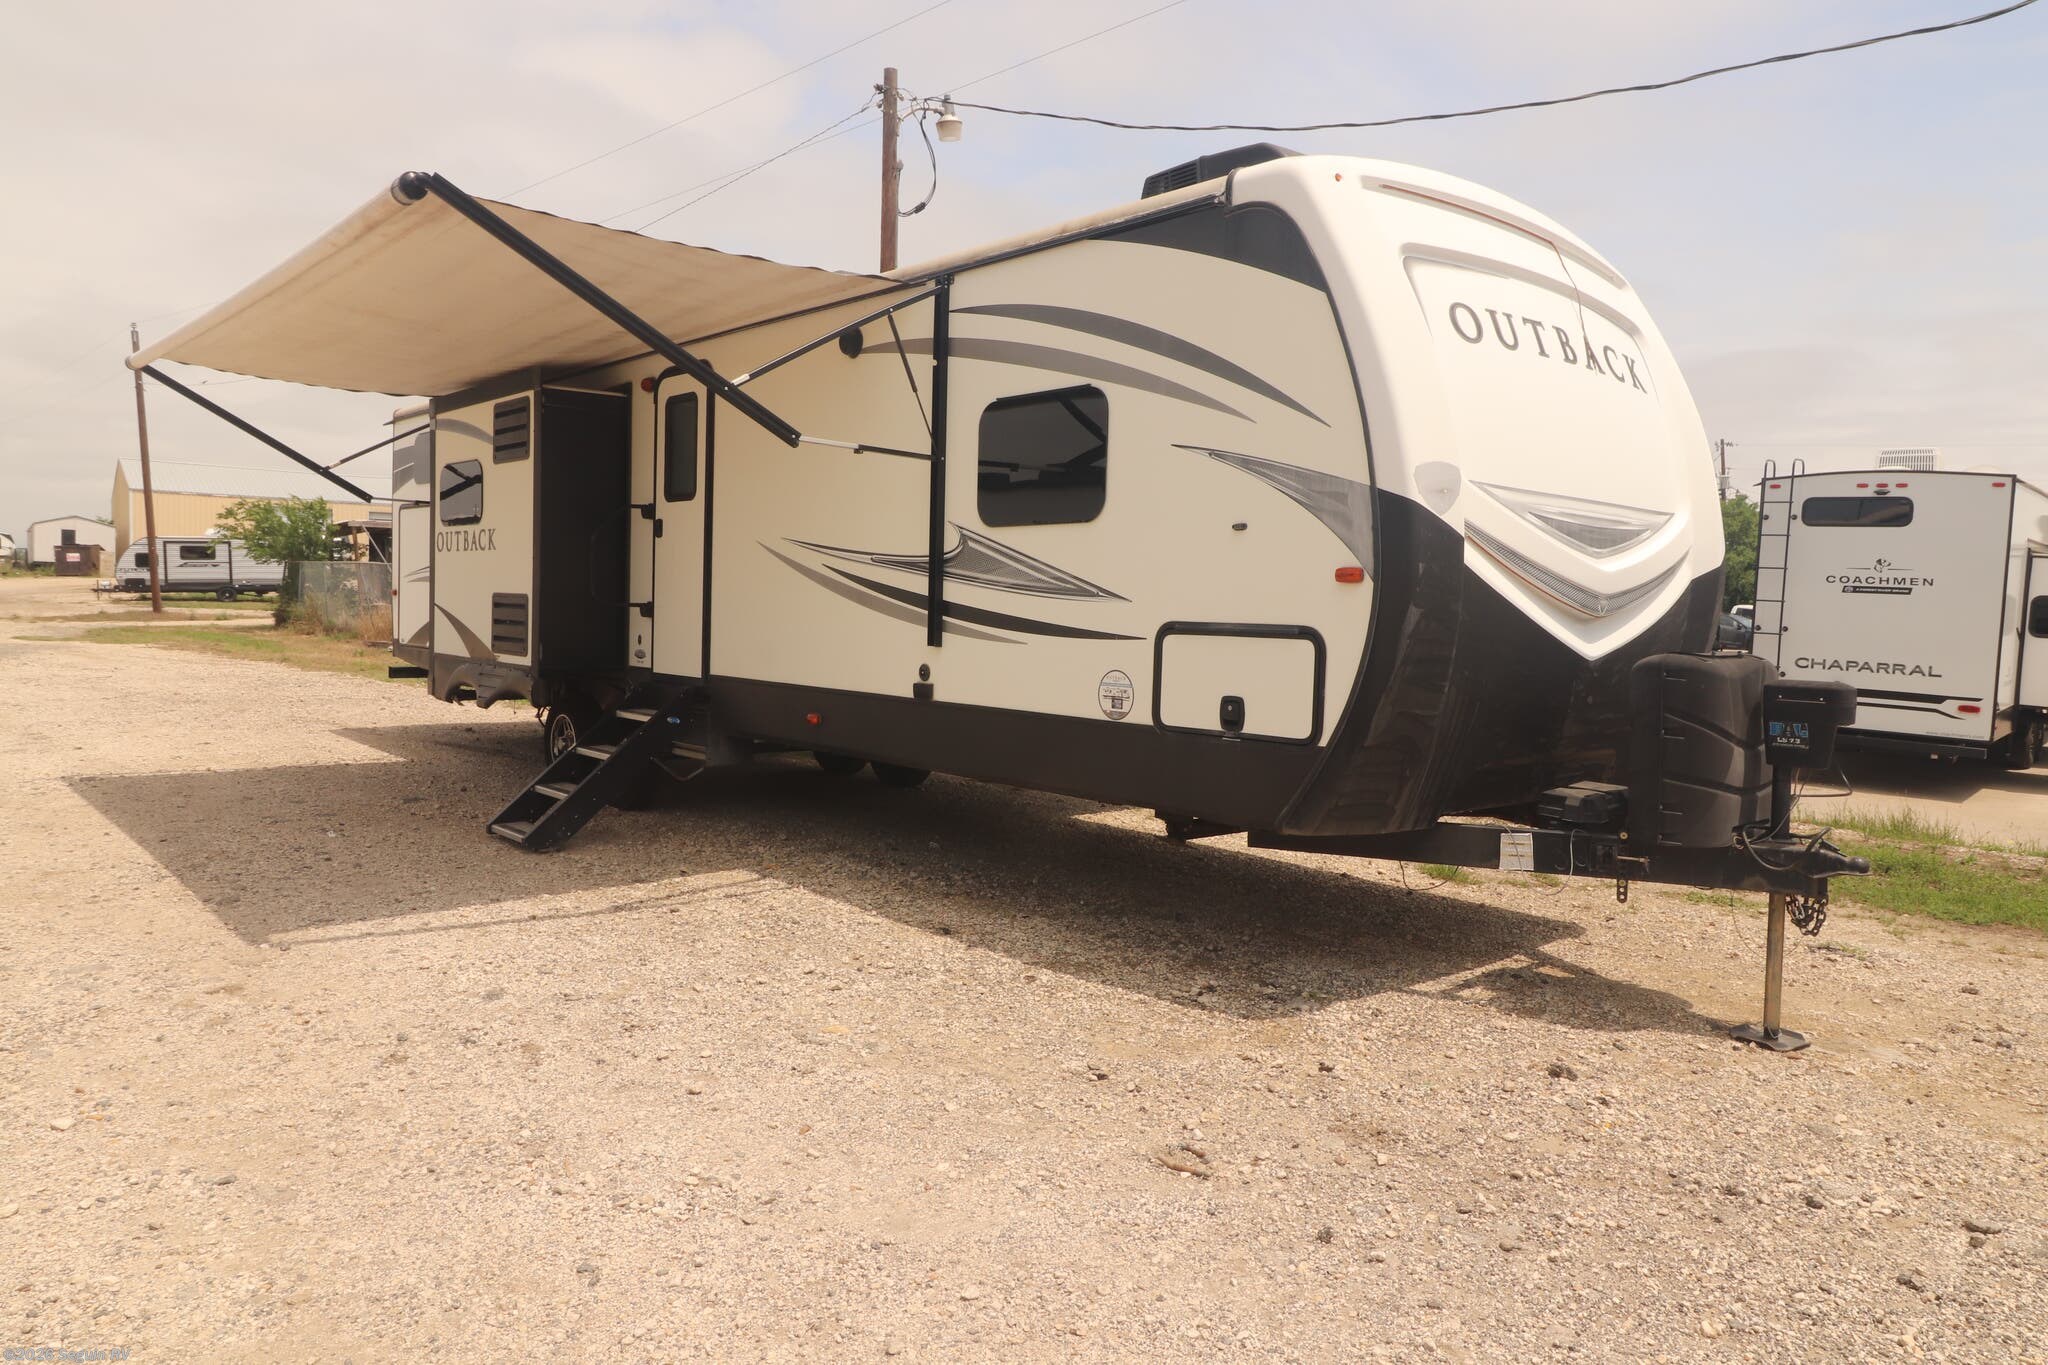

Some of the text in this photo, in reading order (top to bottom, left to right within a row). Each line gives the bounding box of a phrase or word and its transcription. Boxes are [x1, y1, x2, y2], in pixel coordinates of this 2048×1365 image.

[1448, 301, 1648, 394] OUTBACK
[436, 528, 497, 553] OUTBACK
[1825, 575, 1935, 587] COACHMEN
[1794, 657, 1943, 678] CHAPARRAL
